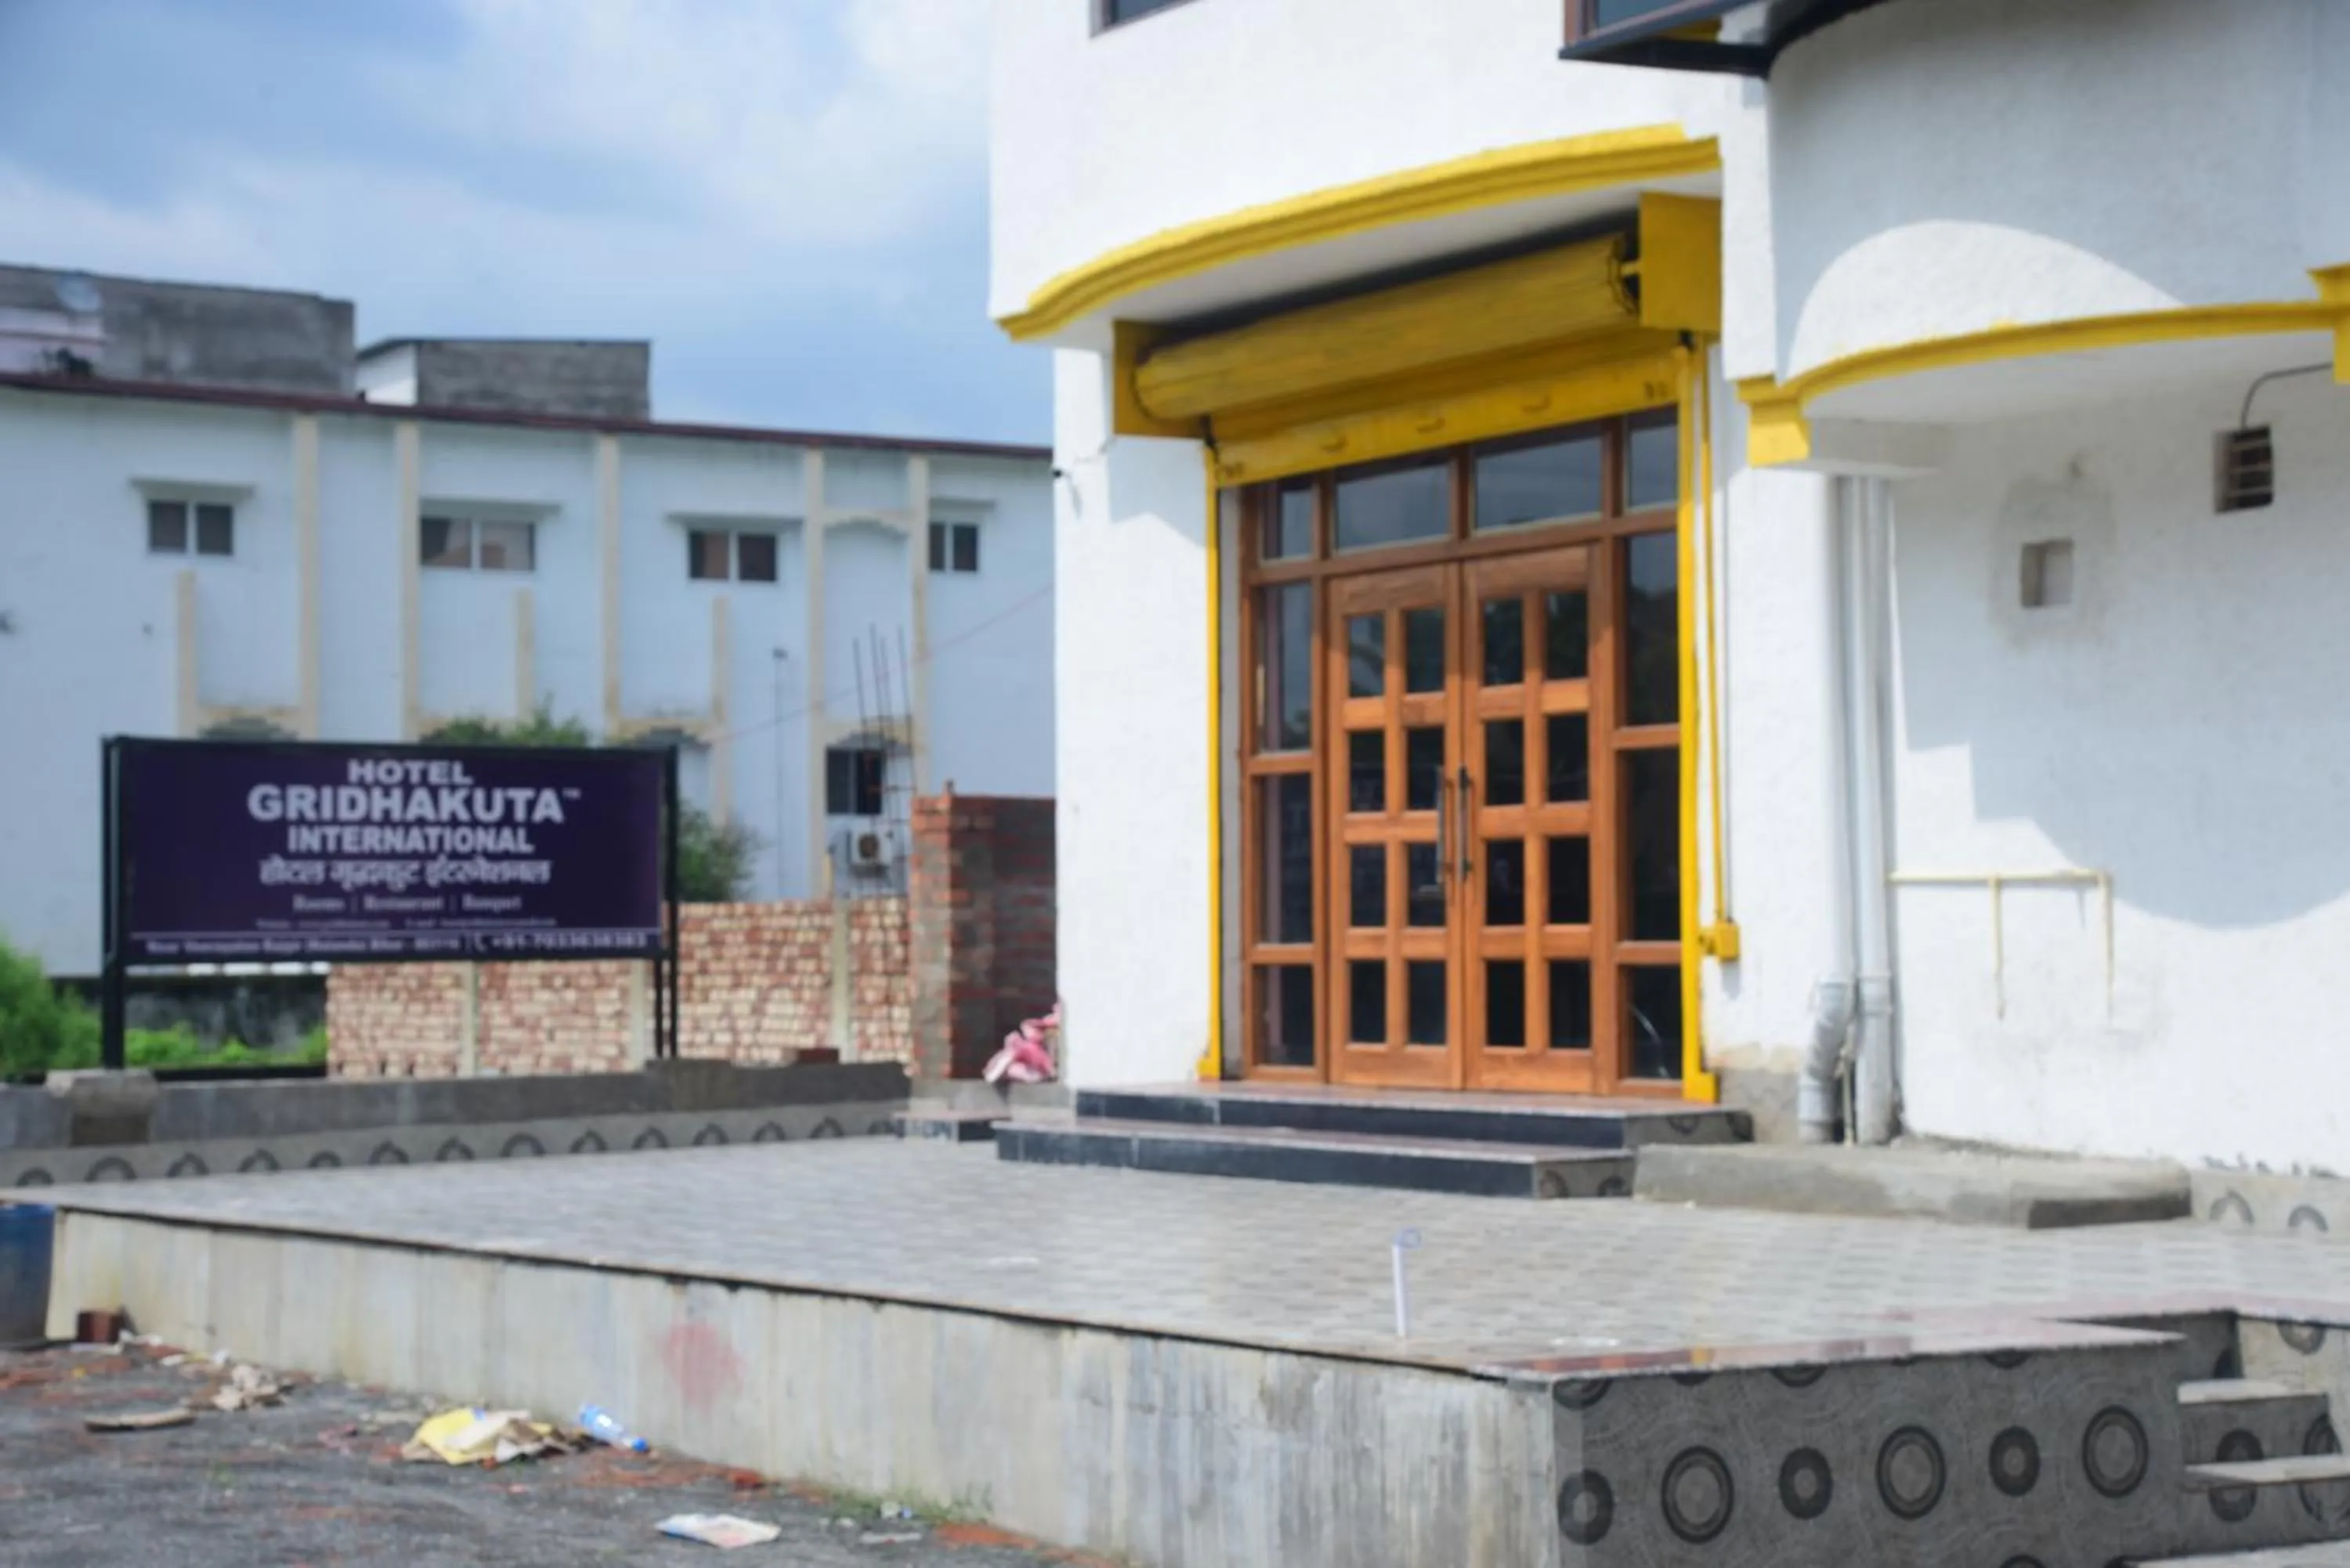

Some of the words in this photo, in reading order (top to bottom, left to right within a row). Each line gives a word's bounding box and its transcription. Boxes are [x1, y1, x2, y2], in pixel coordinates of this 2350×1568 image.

[347, 758, 473, 785] HOTEL
[247, 785, 563, 823] GRIDHAKUTA
[287, 825, 534, 854] INTERNATIONAL
